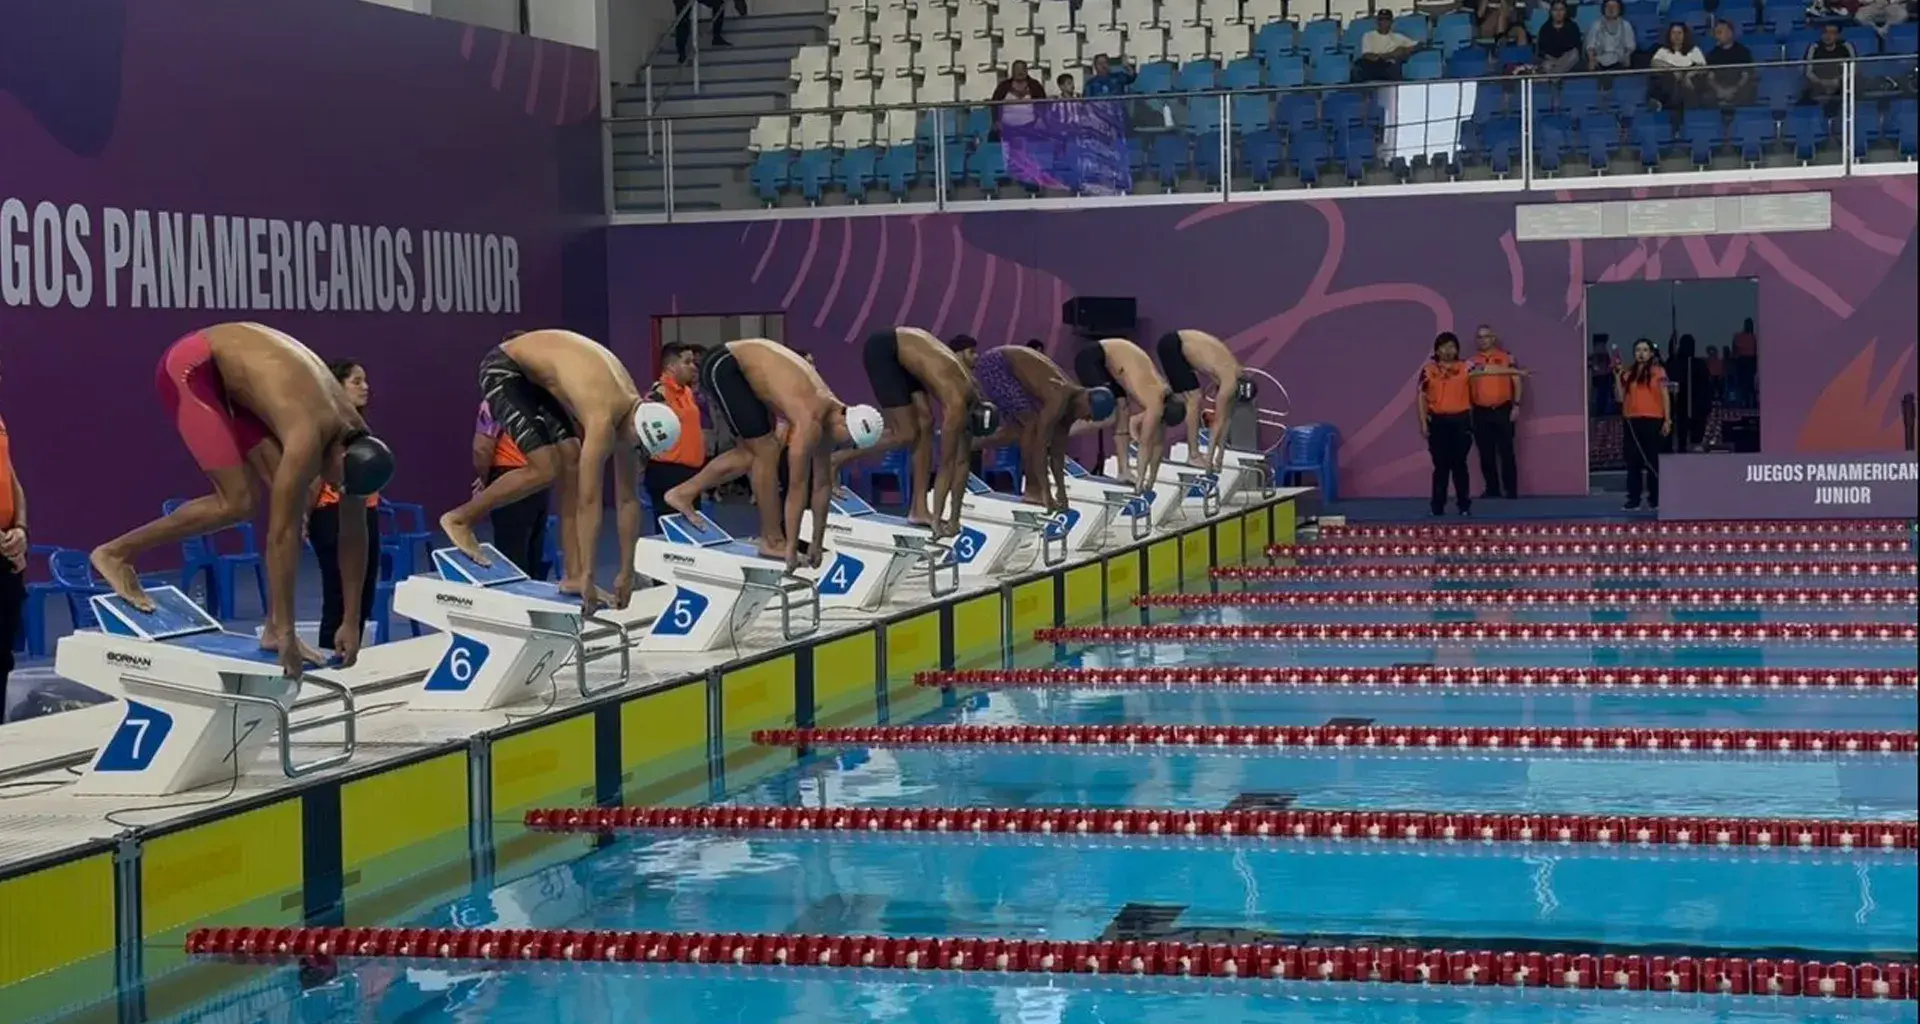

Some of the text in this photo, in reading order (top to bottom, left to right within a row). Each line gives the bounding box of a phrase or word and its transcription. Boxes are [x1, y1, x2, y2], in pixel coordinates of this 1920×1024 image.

[0, 197, 521, 314] GOS PANAMERICANOS JUNIOR
[1746, 462, 1918, 482] JUEGOS PANAMERICAN
[1814, 486, 1871, 504] JUNIOR
[960, 535, 975, 558] 3
[830, 563, 848, 589] 4
[673, 599, 692, 628] 5
[106, 651, 151, 666] BORNAN
[450, 647, 472, 681] 6
[125, 719, 150, 760] 7
